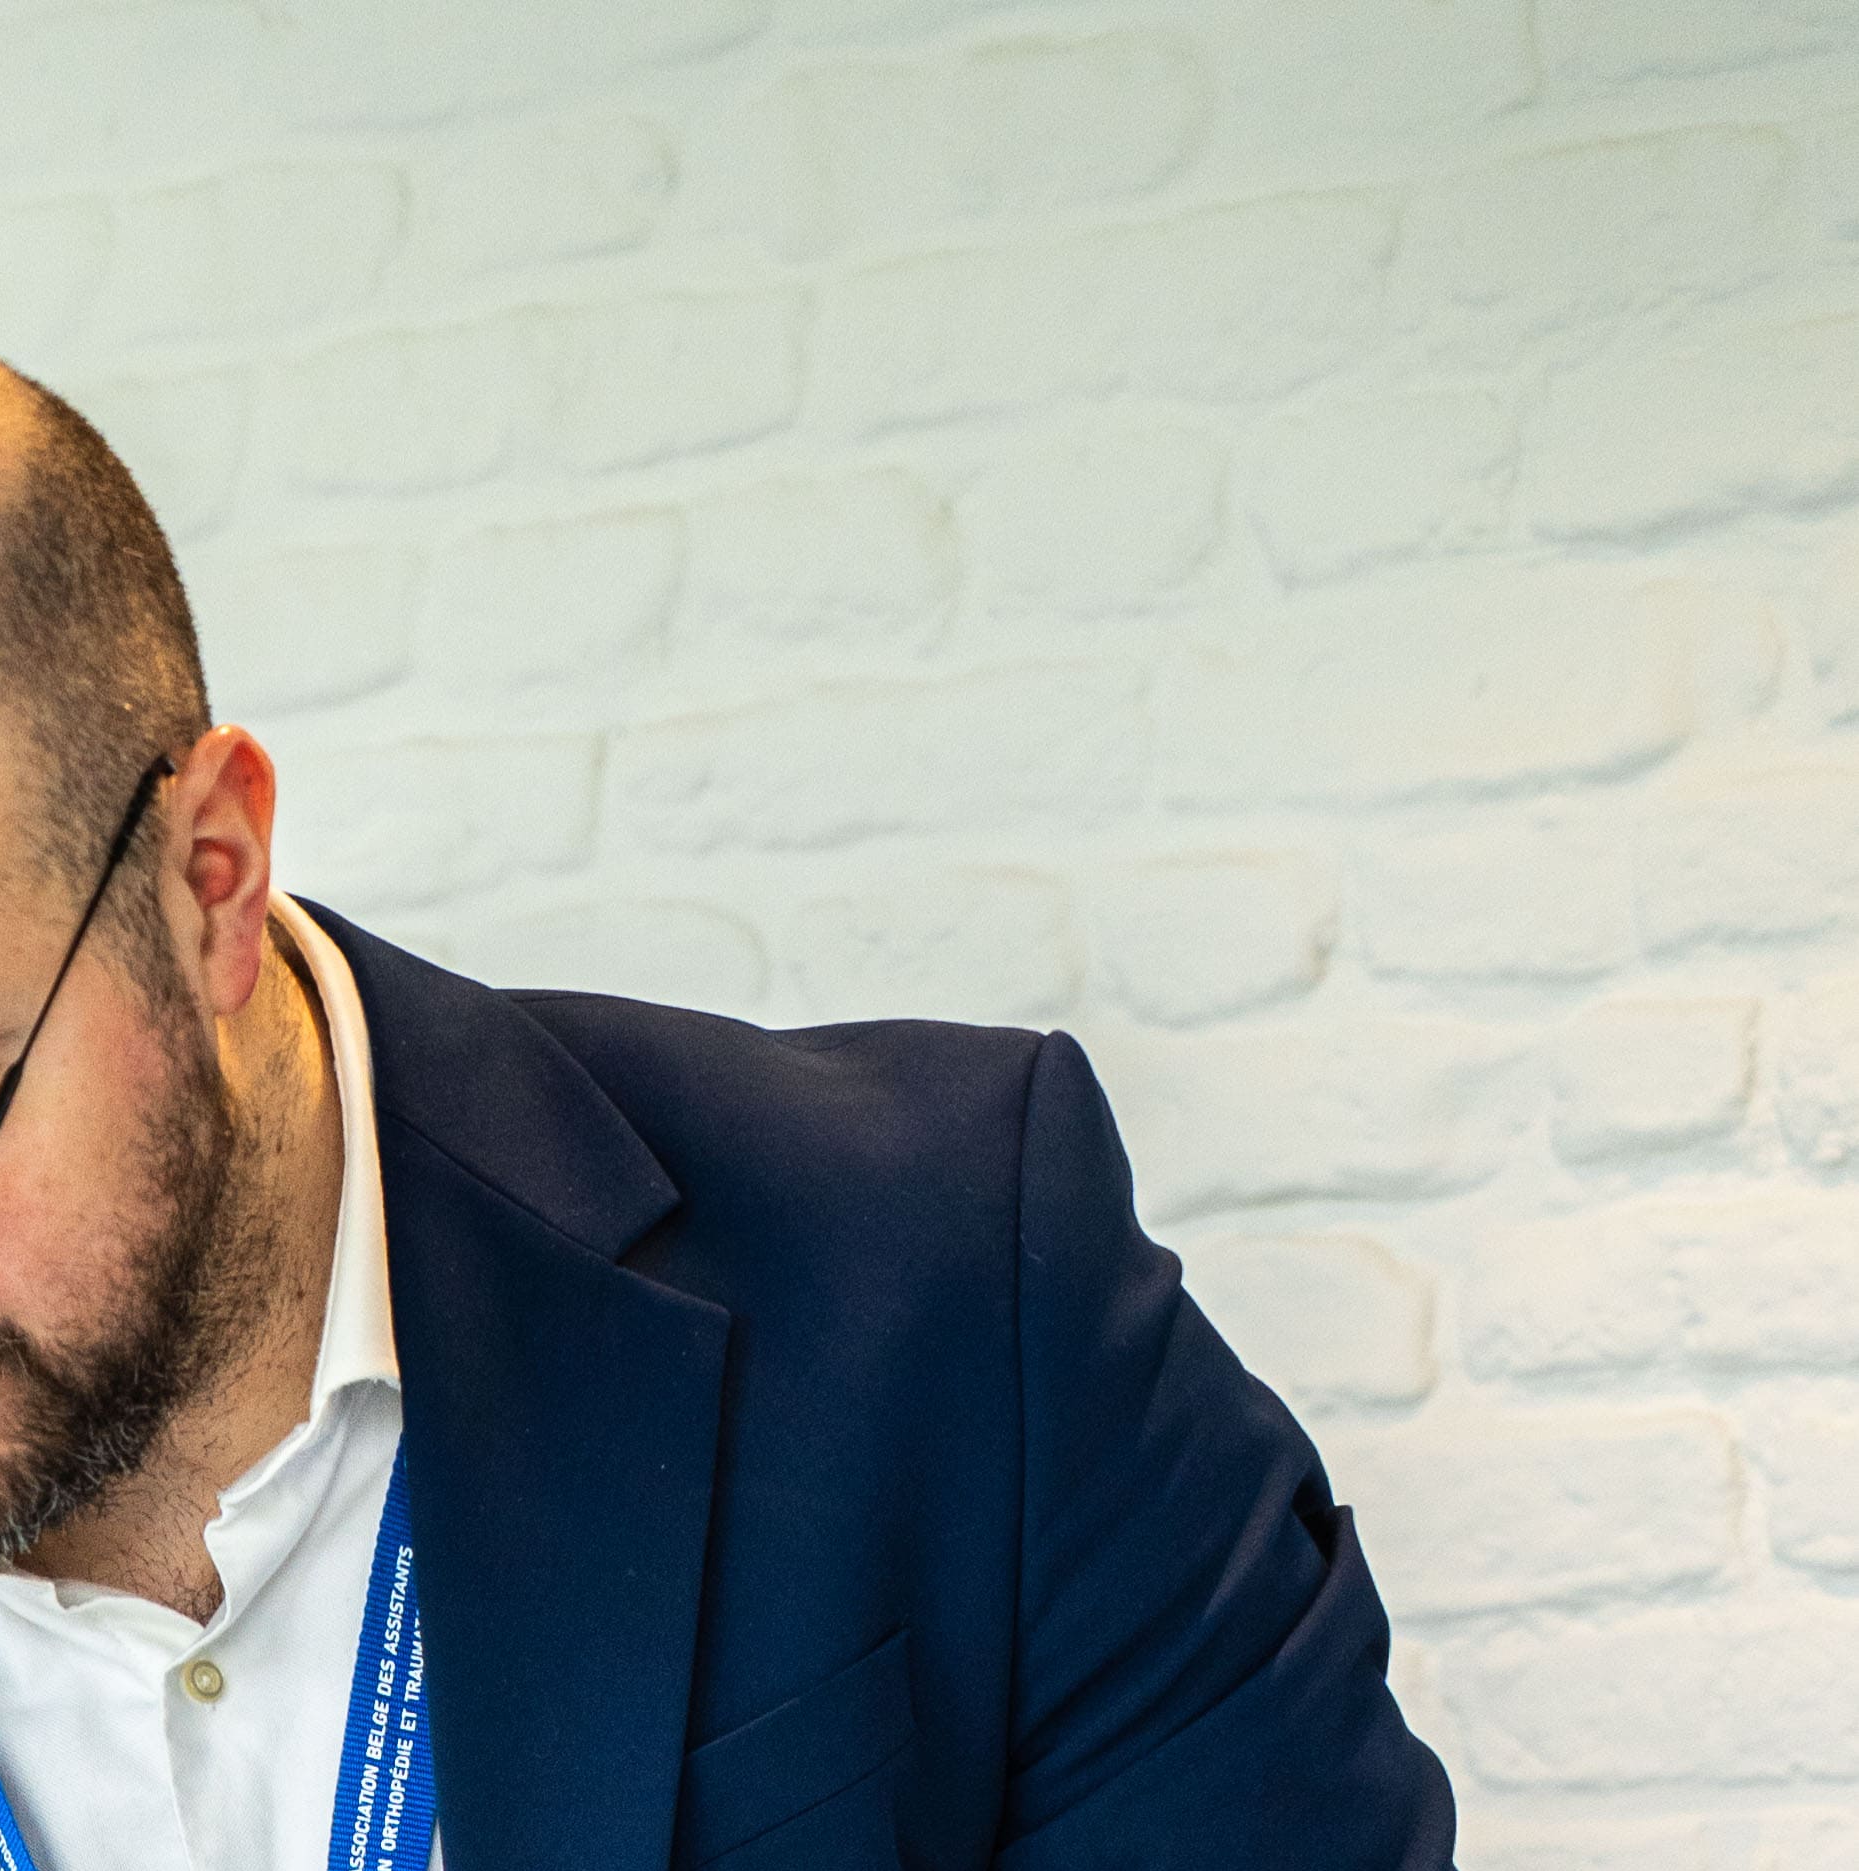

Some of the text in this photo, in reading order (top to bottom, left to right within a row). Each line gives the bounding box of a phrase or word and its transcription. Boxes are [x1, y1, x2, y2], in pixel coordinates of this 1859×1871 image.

[384, 1544, 414, 1656] ASSISTANTS
[377, 1658, 396, 1697] DES
[404, 1608, 425, 1702] TRAUMAT
[366, 1699, 390, 1761] BELGE
[400, 1708, 417, 1732] ET
[380, 1738, 414, 1852] ORTHOPÉDIE
